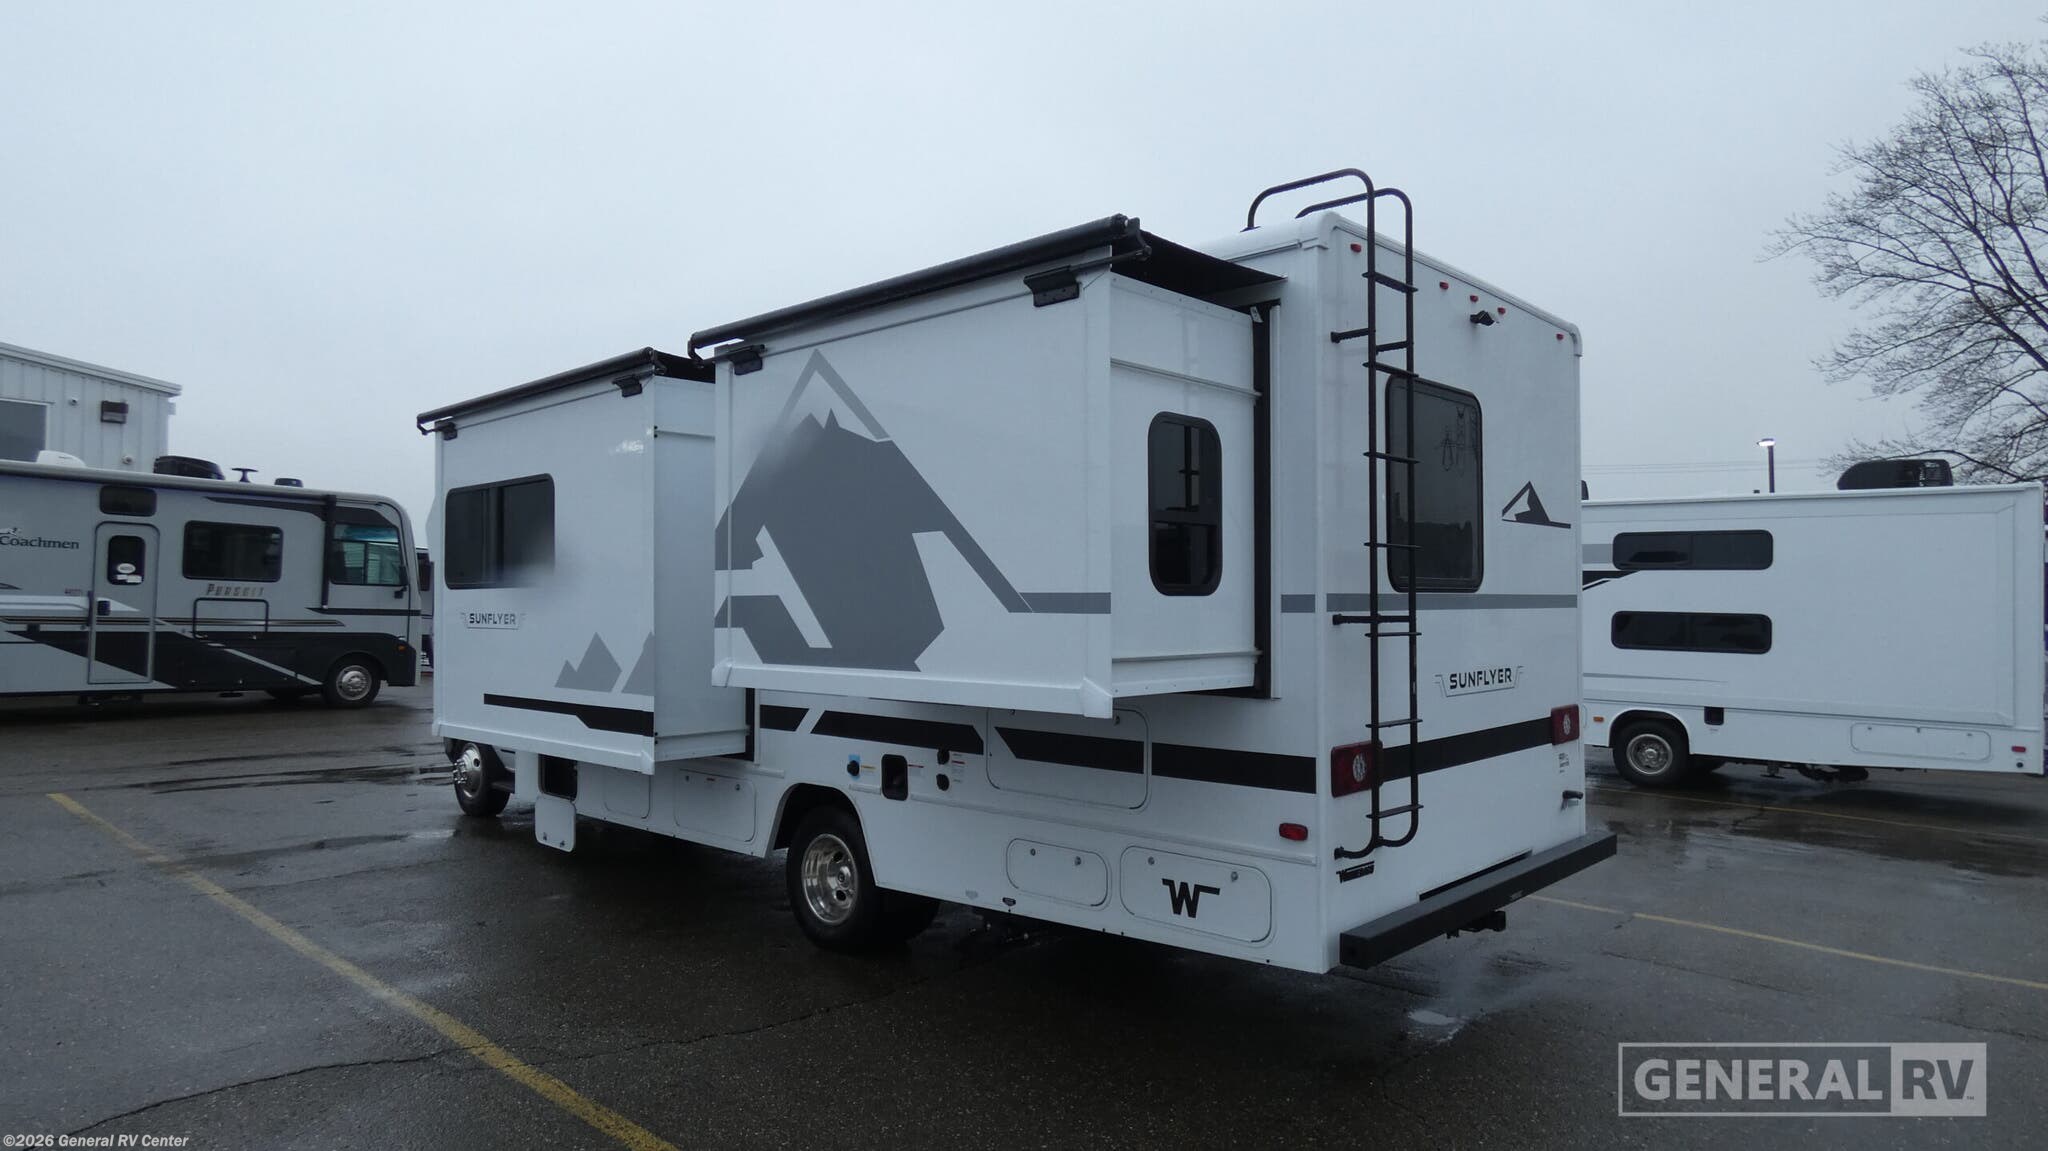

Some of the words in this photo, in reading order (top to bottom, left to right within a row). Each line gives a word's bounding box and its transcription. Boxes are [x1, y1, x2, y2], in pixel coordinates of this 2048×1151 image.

[0, 535, 80, 549] Coachmen
[469, 612, 516, 624] SUNFLYER
[1449, 667, 1512, 690] SUNFLYER
